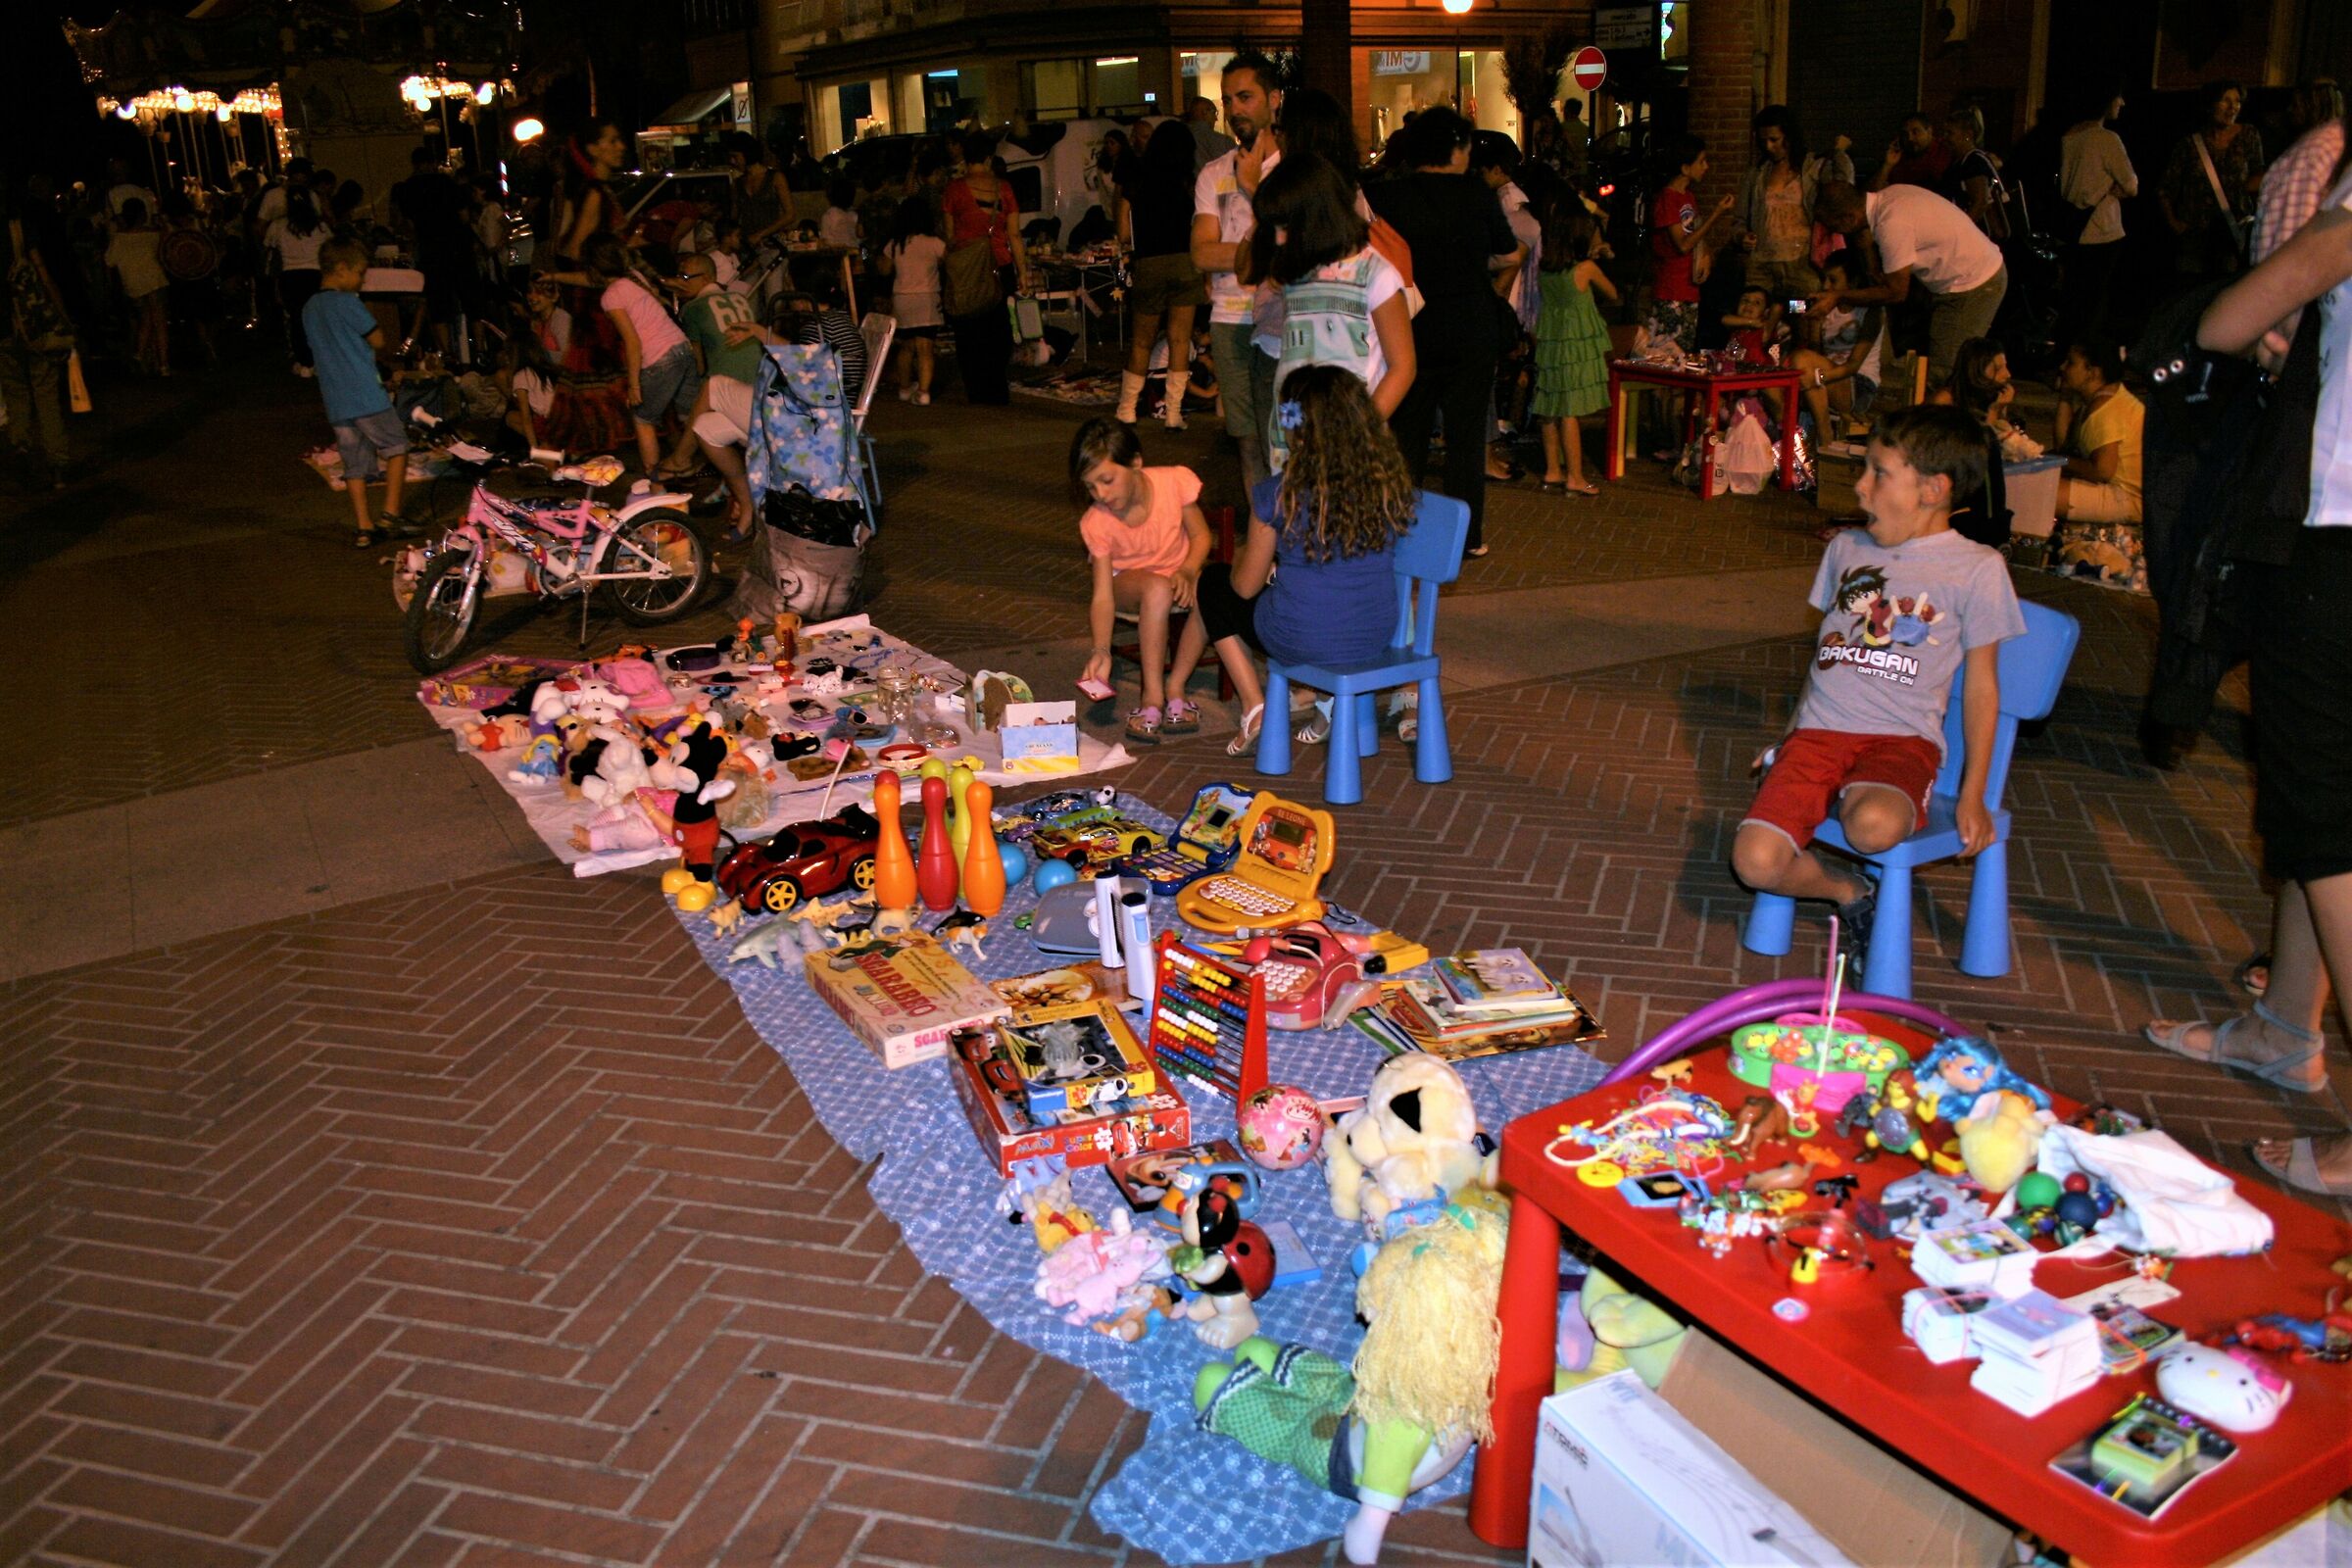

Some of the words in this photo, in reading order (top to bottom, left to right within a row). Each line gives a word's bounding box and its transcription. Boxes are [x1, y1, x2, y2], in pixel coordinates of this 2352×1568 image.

[708, 293, 756, 334] 68
[1819, 646, 1919, 675] BAKUGAN
[1857, 666, 1898, 681] BATTLE
[1900, 676, 1914, 685] ON
